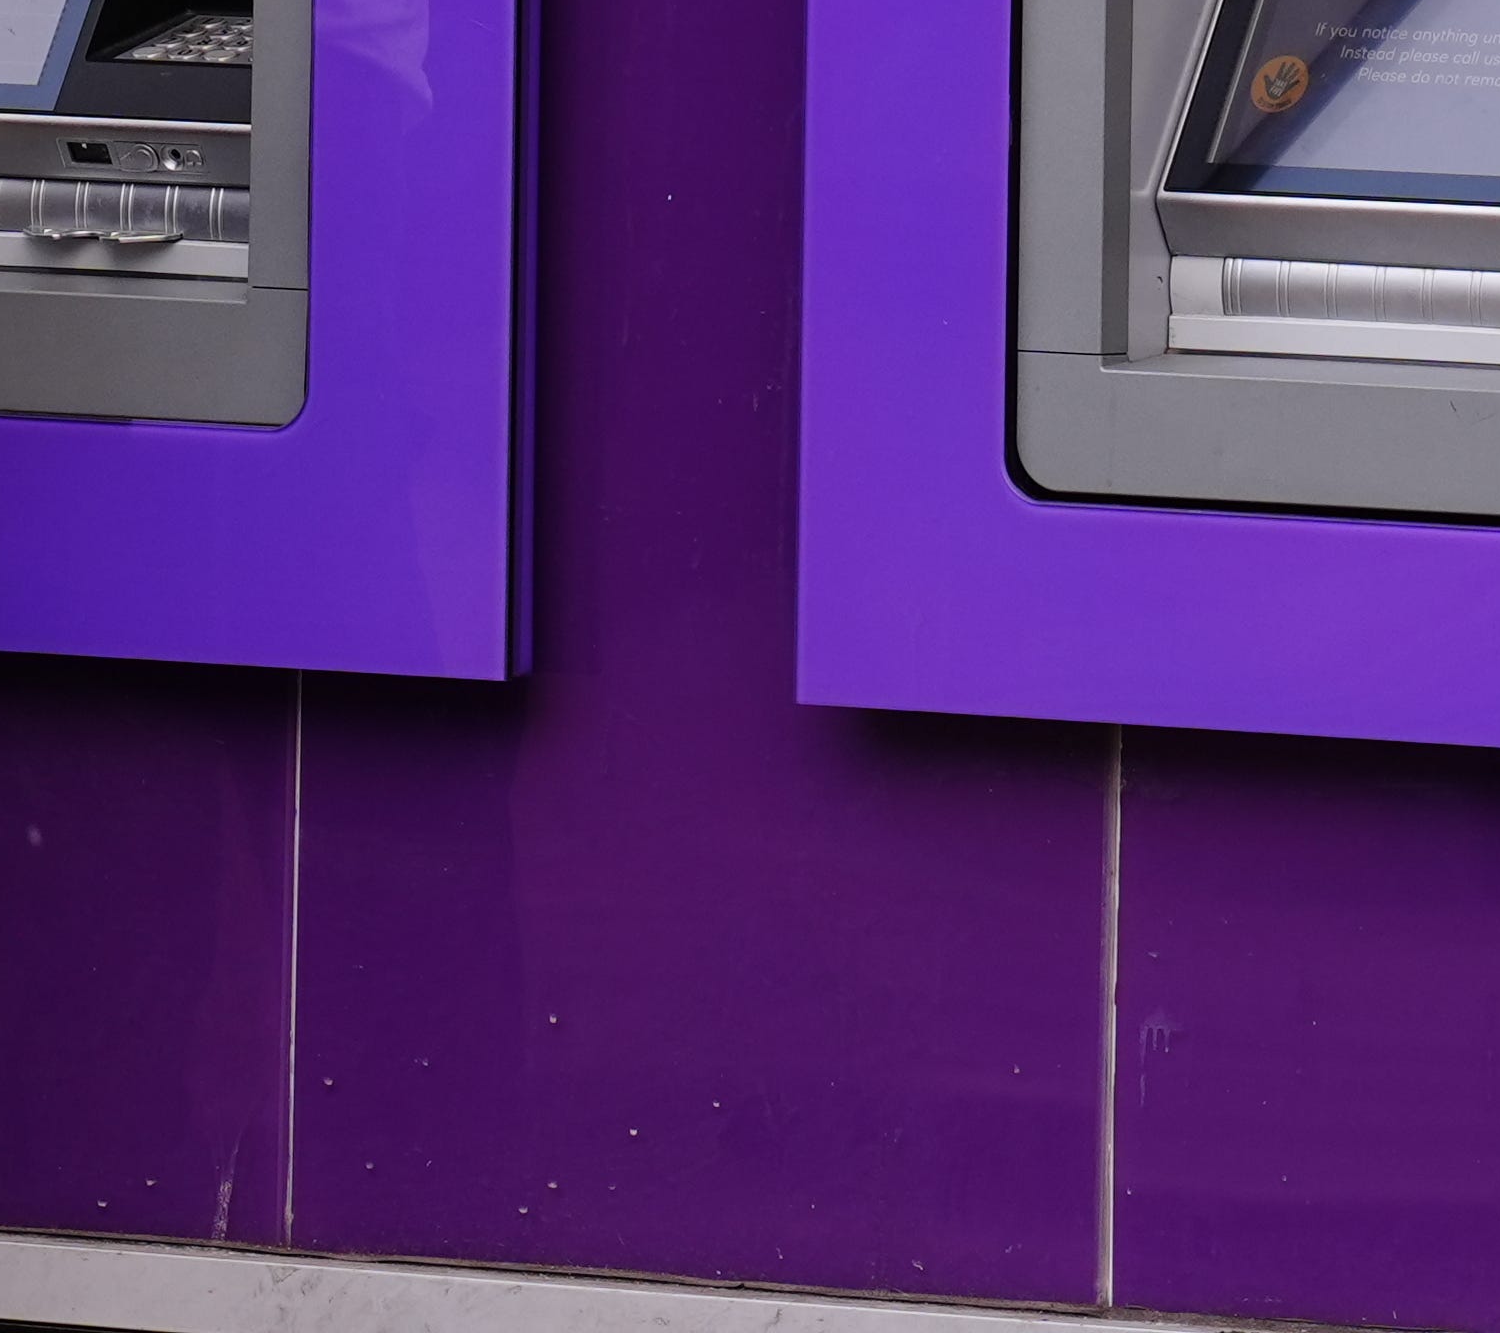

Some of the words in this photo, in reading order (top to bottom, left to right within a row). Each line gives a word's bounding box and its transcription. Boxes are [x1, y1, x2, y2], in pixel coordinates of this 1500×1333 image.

[1314, 22, 1328, 37] If
[1330, 26, 1357, 40] you
[1361, 25, 1409, 41] notice
[1412, 29, 1478, 46] anything
[1340, 46, 1397, 61] Instead
[1398, 48, 1449, 65] please
[1453, 50, 1481, 65] call
[1357, 66, 1407, 83] Please
[1411, 69, 1431, 84] do
[1434, 71, 1460, 85] not
